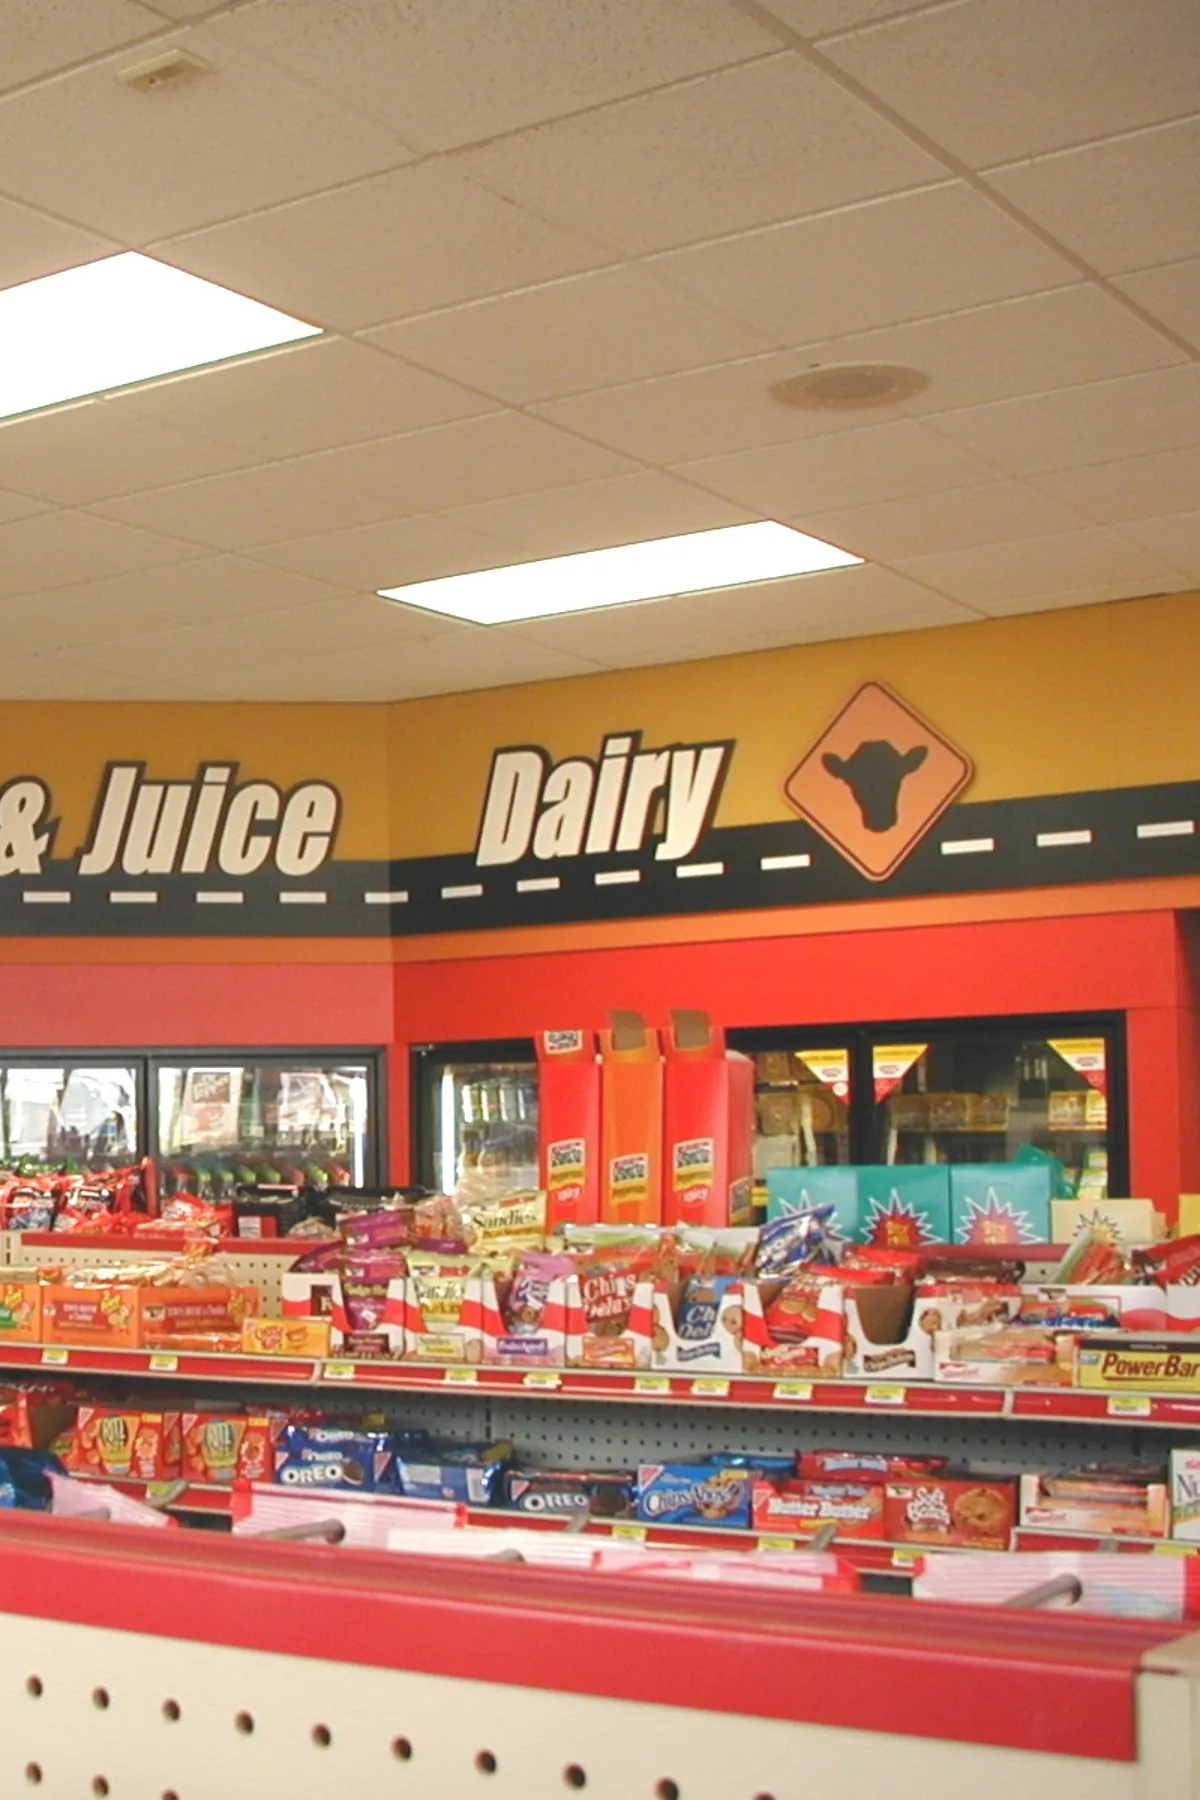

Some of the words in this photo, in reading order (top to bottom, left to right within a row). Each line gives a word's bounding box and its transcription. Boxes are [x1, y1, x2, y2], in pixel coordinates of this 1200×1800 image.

[476, 736, 726, 867] Dairy
[78, 765, 338, 876] Juice
[472, 1205, 539, 1229] Sandies
[1100, 1351, 1200, 1377] PowerBar
[281, 1465, 343, 1484] OREO
[524, 1491, 589, 1511] OREO
